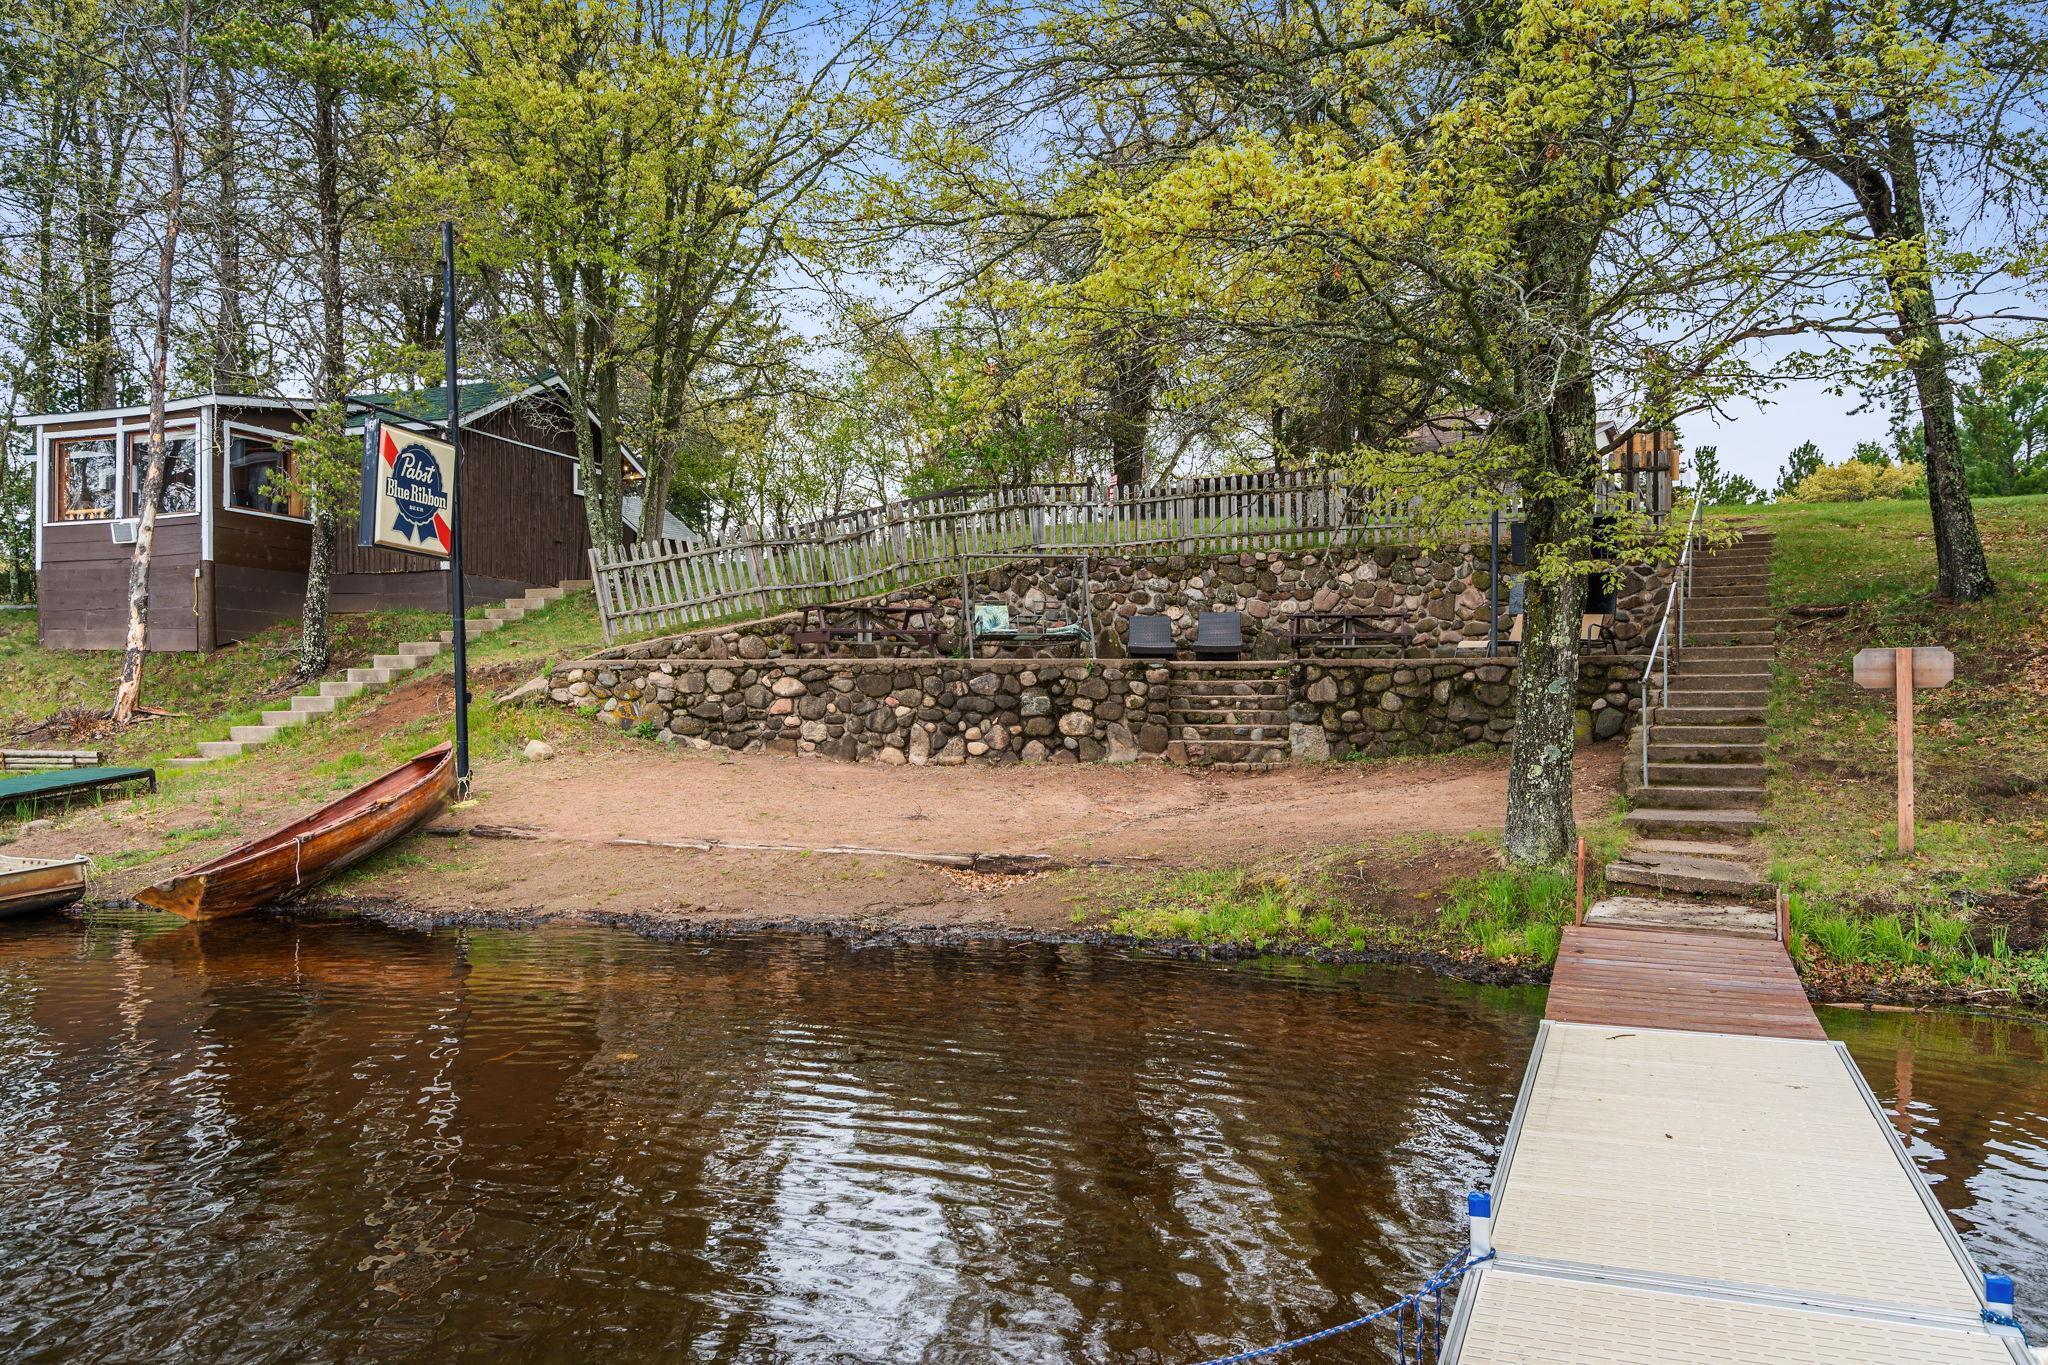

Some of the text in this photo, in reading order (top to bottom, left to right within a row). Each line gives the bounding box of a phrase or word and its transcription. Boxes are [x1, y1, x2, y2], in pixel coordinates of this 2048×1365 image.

[401, 453, 435, 483] Pabst
[387, 478, 447, 509] Blue Ribbon
